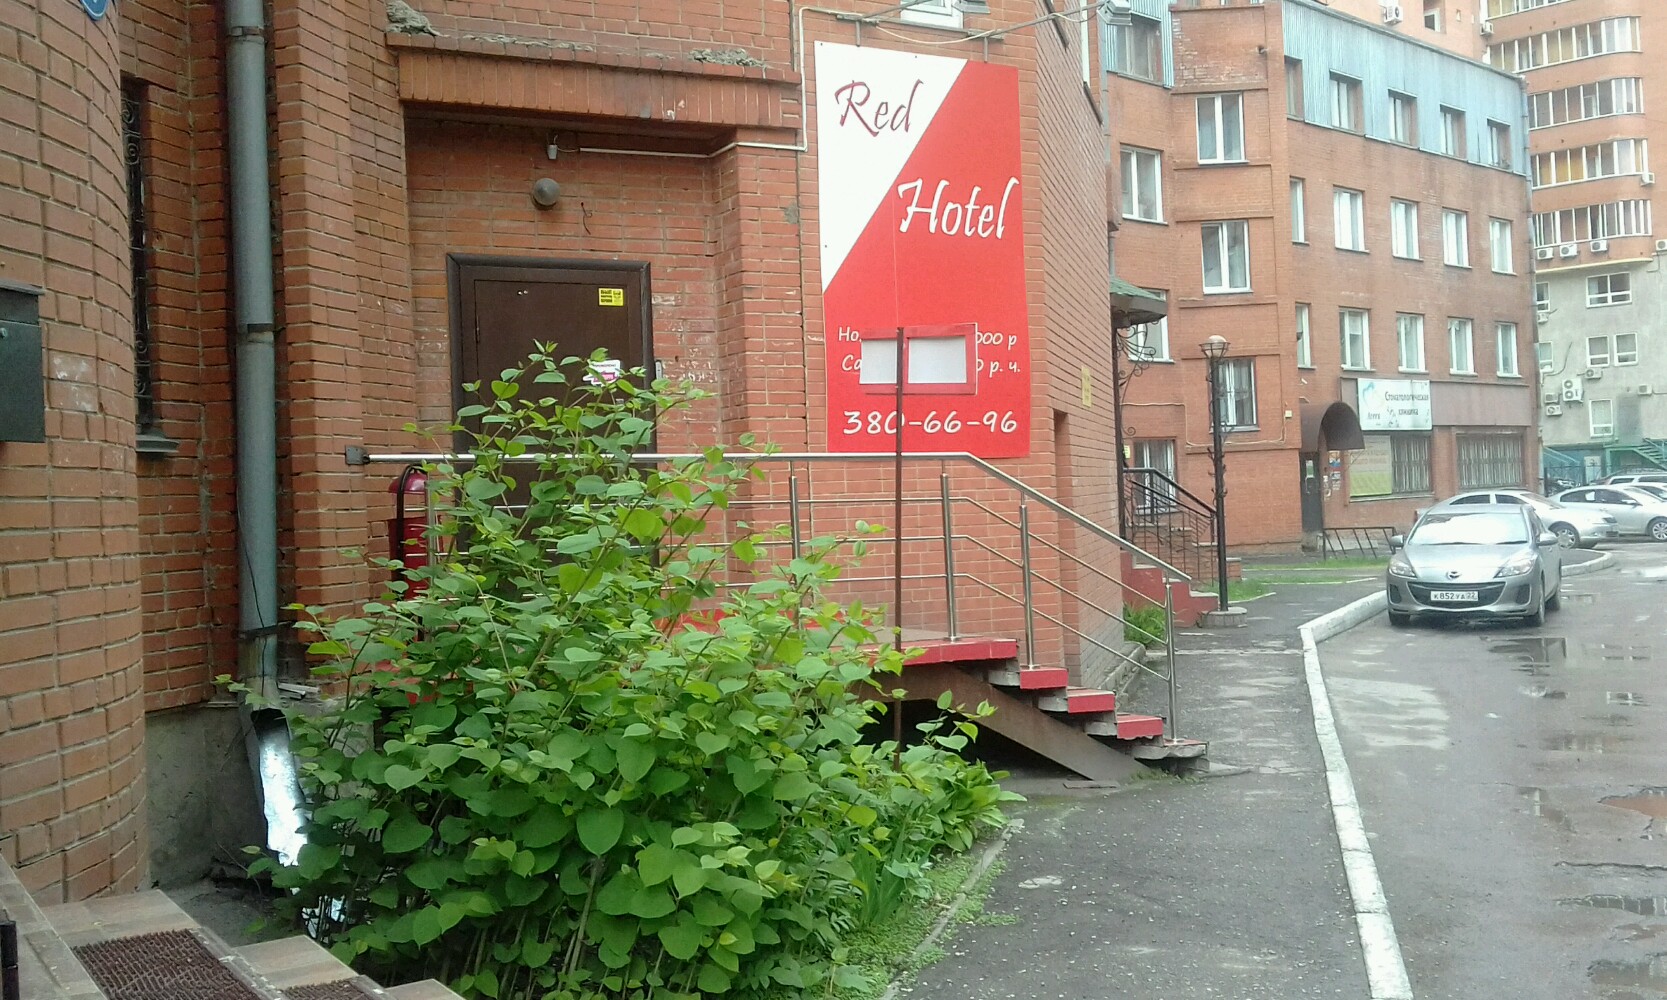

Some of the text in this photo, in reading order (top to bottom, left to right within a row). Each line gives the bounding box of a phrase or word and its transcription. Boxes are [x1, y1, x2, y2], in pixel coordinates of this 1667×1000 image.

[835, 79, 924, 138] Red
[897, 176, 1020, 240] Hotel
[976, 331, 1004, 345] 000
[843, 410, 1018, 435] 380-66-96
